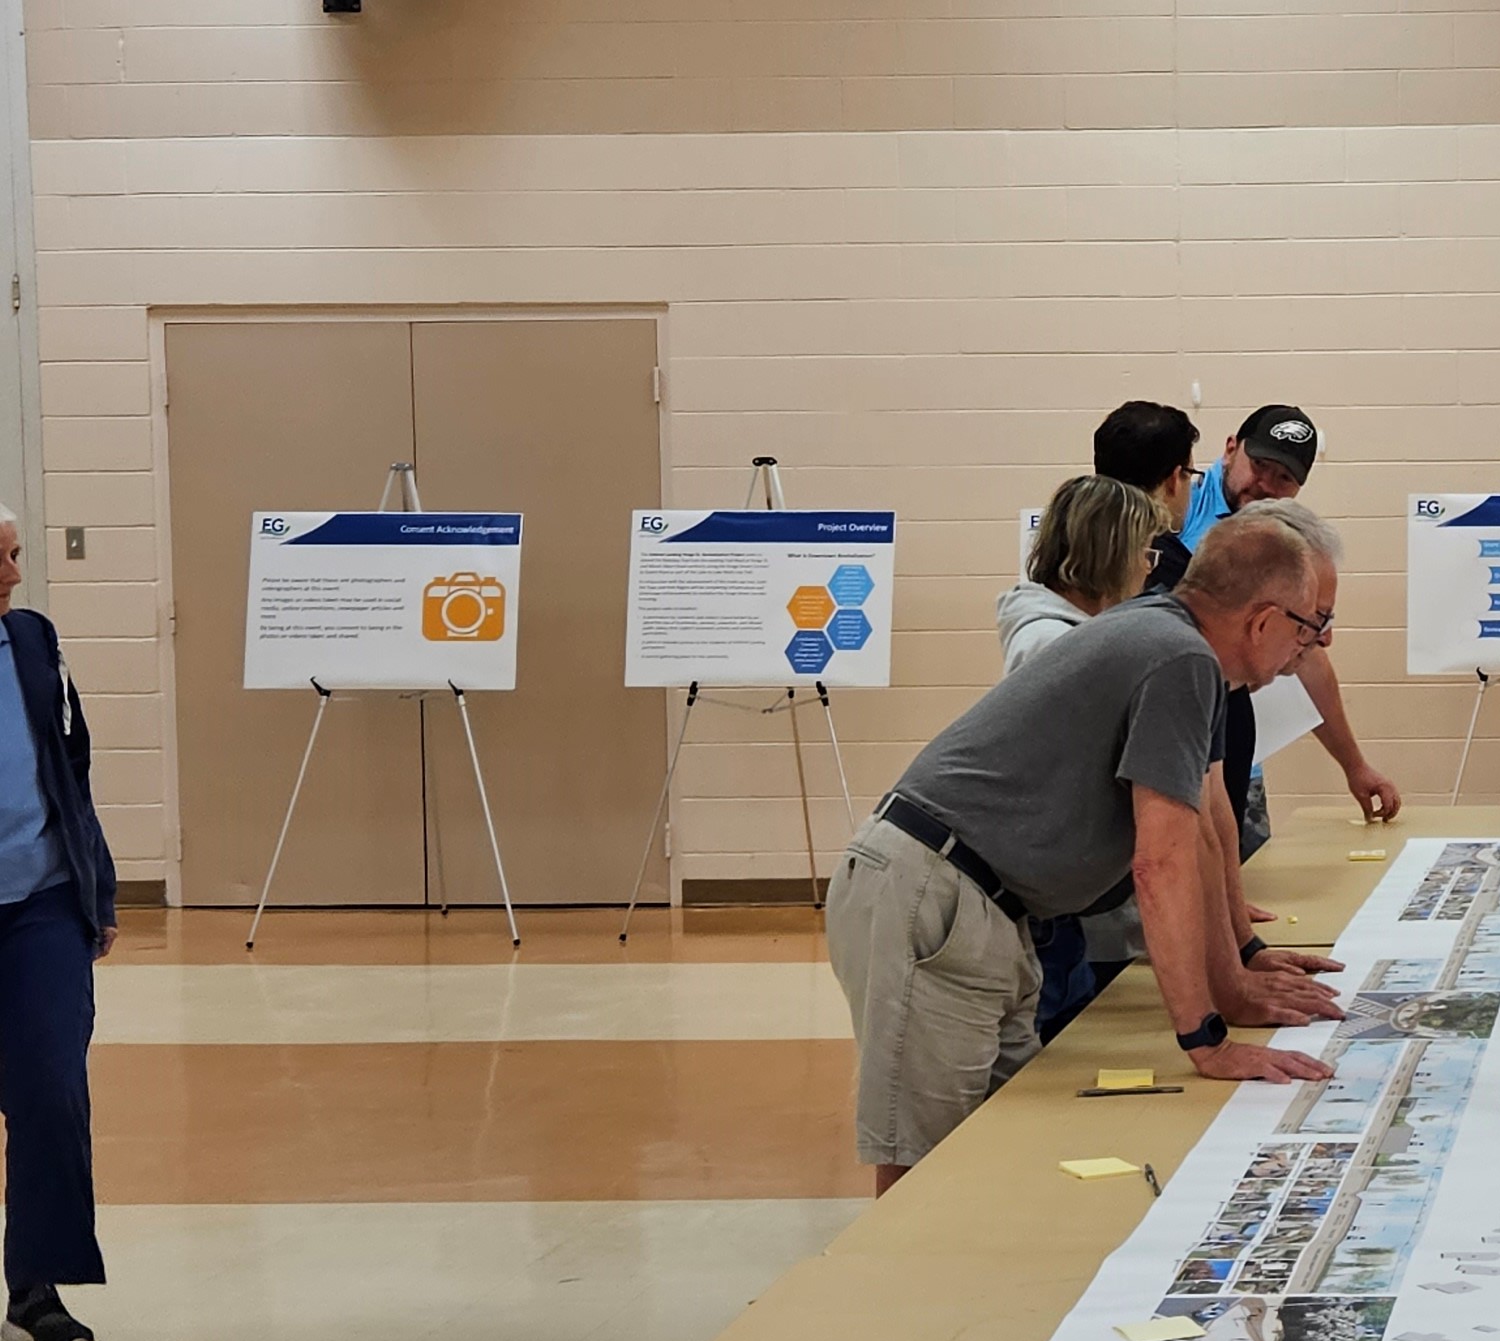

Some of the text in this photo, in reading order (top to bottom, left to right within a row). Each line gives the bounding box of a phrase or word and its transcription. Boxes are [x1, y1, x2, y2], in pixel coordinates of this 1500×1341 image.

[1417, 500, 1439, 515] EG
[262, 518, 284, 532] EG
[641, 516, 663, 530] EG
[817, 523, 888, 533] Project Overview
[1031, 515, 1040, 528] E
[400, 525, 514, 535] Consent Acknowledgement
